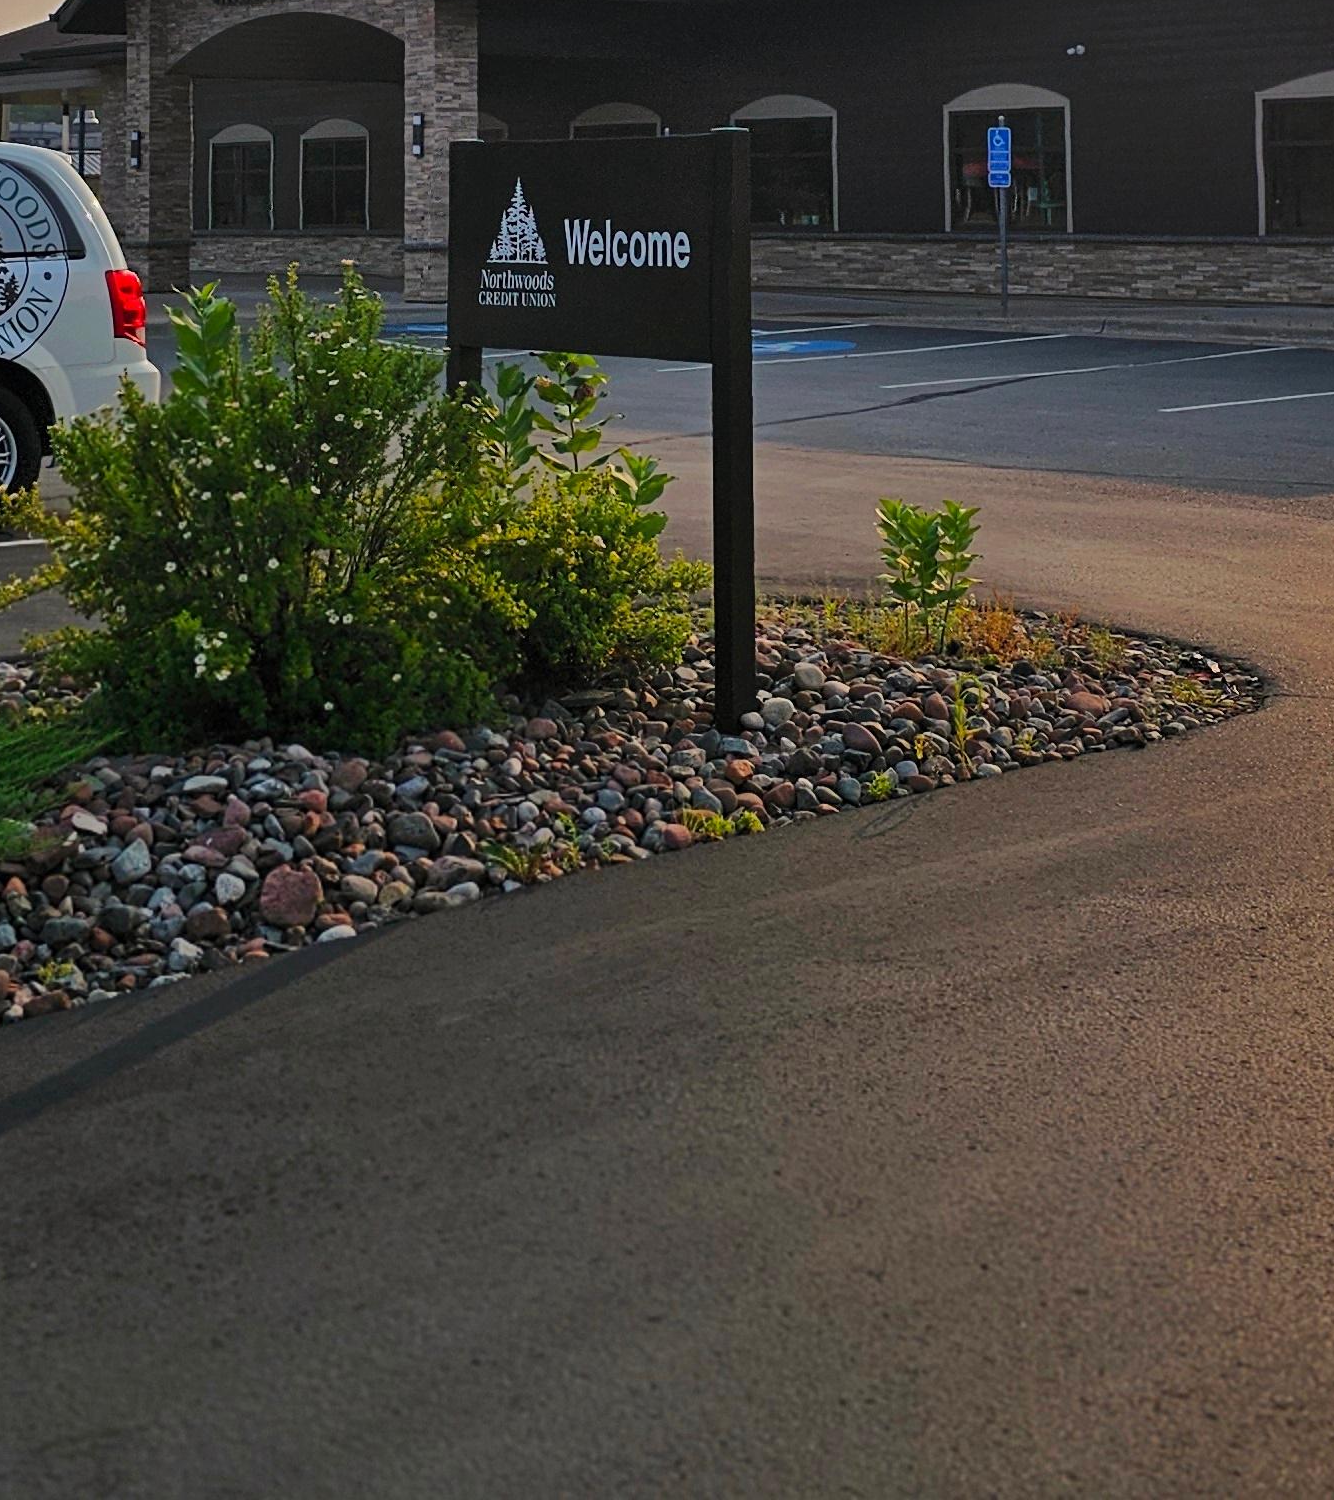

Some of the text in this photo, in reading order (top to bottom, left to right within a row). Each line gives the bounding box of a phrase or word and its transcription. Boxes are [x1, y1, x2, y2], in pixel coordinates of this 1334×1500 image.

[564, 218, 691, 269] Welcome
[480, 269, 555, 291] Northwoods
[478, 291, 557, 308] CREDIT UNION
